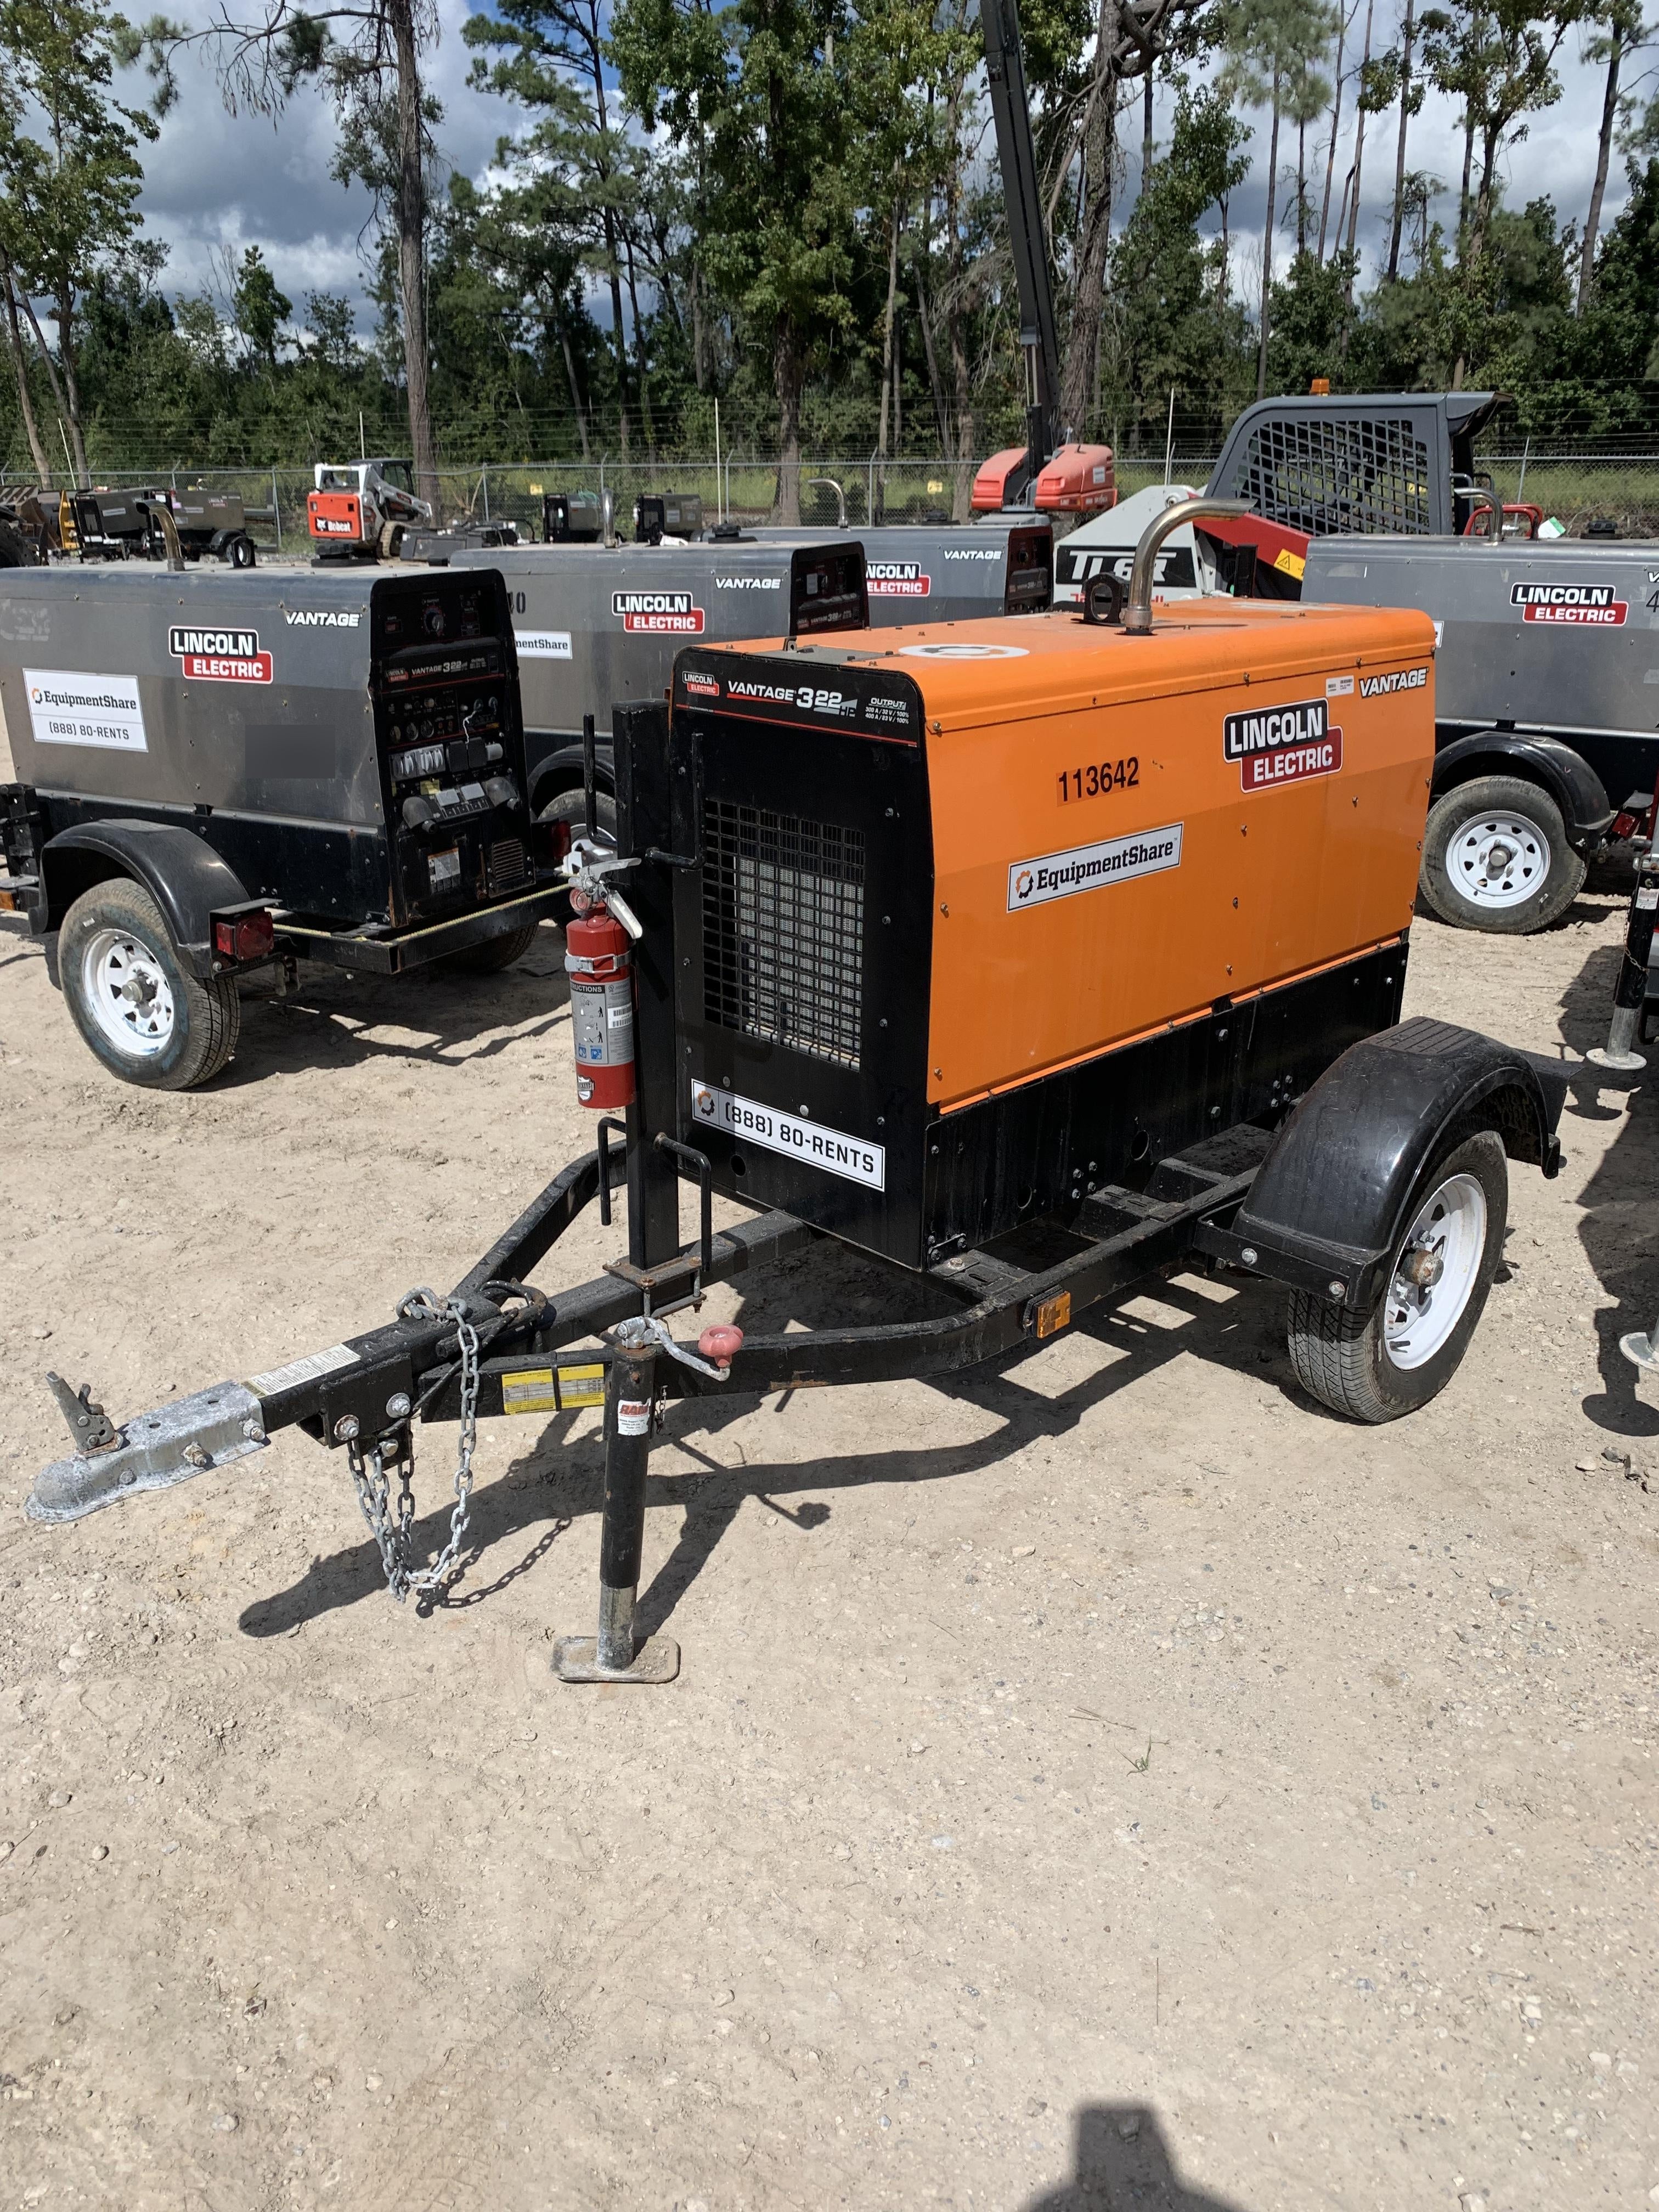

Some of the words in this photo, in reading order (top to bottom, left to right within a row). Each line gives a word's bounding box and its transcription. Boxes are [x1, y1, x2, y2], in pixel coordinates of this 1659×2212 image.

[328, 521, 351, 532] Bobcat
[944, 550, 1002, 560] VANTAGE
[866, 565, 916, 580] NCOLN
[715, 578, 781, 589] VANTAGE
[867, 581, 922, 593] ELECTRIC
[617, 595, 687, 613] LINCOLN
[1516, 586, 1609, 606] LINCOLN
[286, 611, 360, 627] VANTAGE
[633, 616, 696, 629] ELECTRIC
[1535, 608, 1616, 622] ELECTRIC
[174, 631, 253, 656] LINCOLN
[515, 639, 568, 650] mentShare
[193, 658, 263, 678] ELECTRIC
[684, 673, 712, 685] LINCOLN
[1360, 668, 1426, 698] VANTAGE
[691, 684, 715, 693] ELECTRIC
[728, 680, 793, 701] VANTAGE
[796, 687, 842, 709] 322
[44, 691, 137, 709] EquipmentShare
[871, 697, 904, 709] OUTPUT
[49, 721, 76, 735] (888)
[80, 725, 129, 740] 80-RENTS
[1230, 707, 1322, 753] LINCOLN
[1253, 744, 1333, 783] ELECTRIC
[1059, 757, 1139, 802] 113642
[1036, 841, 1173, 890] EquipmentShare
[725, 1102, 772, 1137] (888)
[780, 1124, 874, 1173] 80-RENTS
